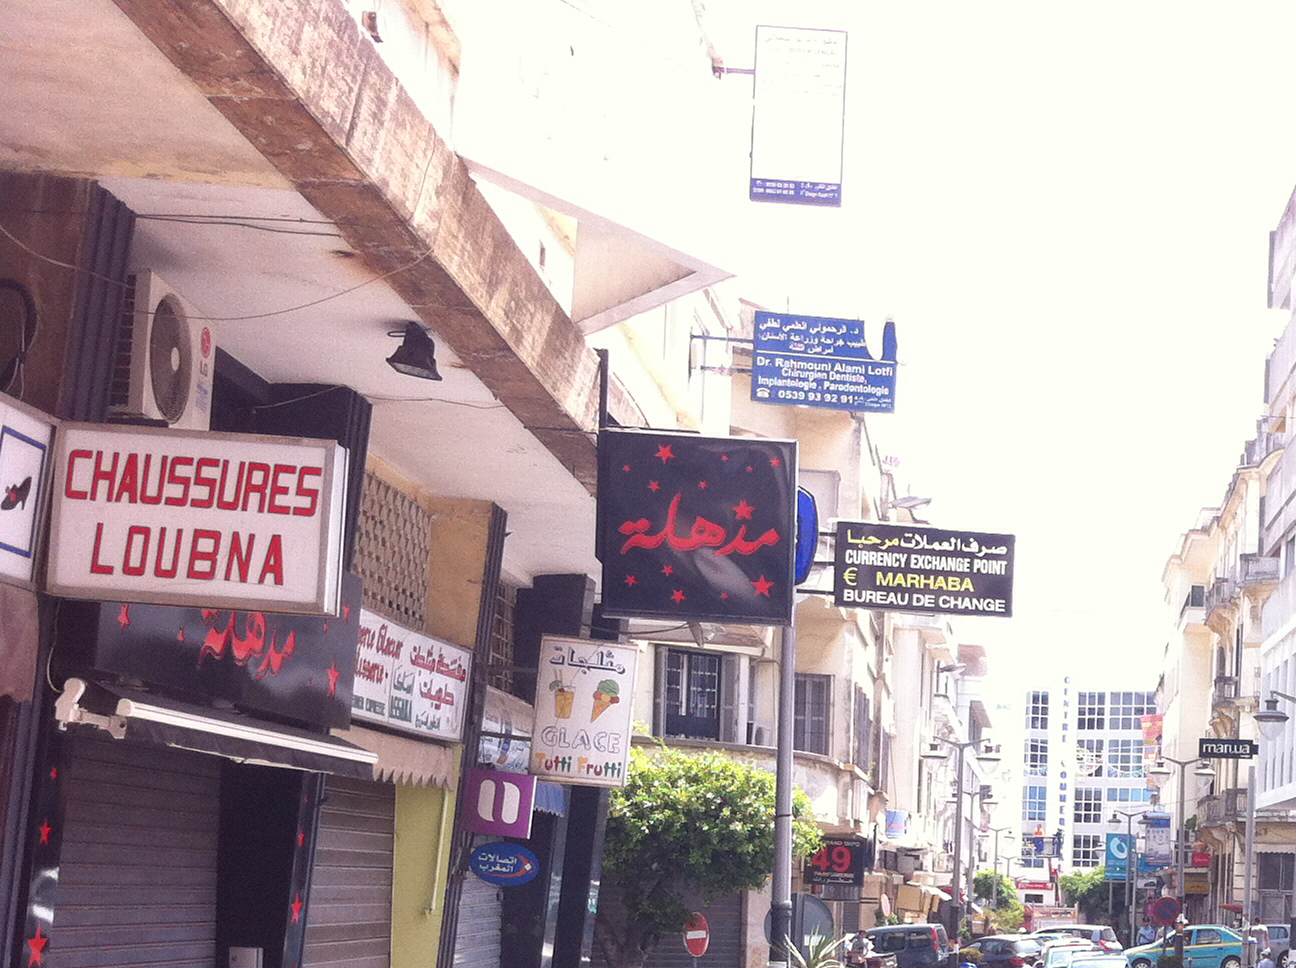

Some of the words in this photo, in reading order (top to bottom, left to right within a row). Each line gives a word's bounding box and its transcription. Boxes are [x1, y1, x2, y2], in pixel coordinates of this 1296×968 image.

[756, 356, 772, 367] Dr.
[775, 358, 832, 372] Rahmouni
[834, 363, 865, 375] Alami
[868, 365, 894, 377] Lotfi
[778, 390, 805, 400] 0539
[64, 448, 322, 517] CHAUSSURES
[847, 529, 899, 549] مرحبا
[900, 533, 962, 552] العملات
[962, 537, 1008, 557] صرف
[90, 522, 284, 586] LOUBNA
[845, 549, 908, 568] CURRENCY
[910, 554, 970, 573] EXCHANGE
[973, 559, 1008, 575] POINT
[875, 571, 975, 592] MARHABA
[843, 589, 909, 606] BUREAU
[912, 594, 936, 607] DE
[938, 597, 1006, 612] CHANGE
[549, 645, 626, 675] مثلجات
[541, 725, 621, 753] GLACE
[535, 752, 572, 772] Tutti
[577, 756, 622, 778] Frutti
[811, 847, 852, 873] 49
